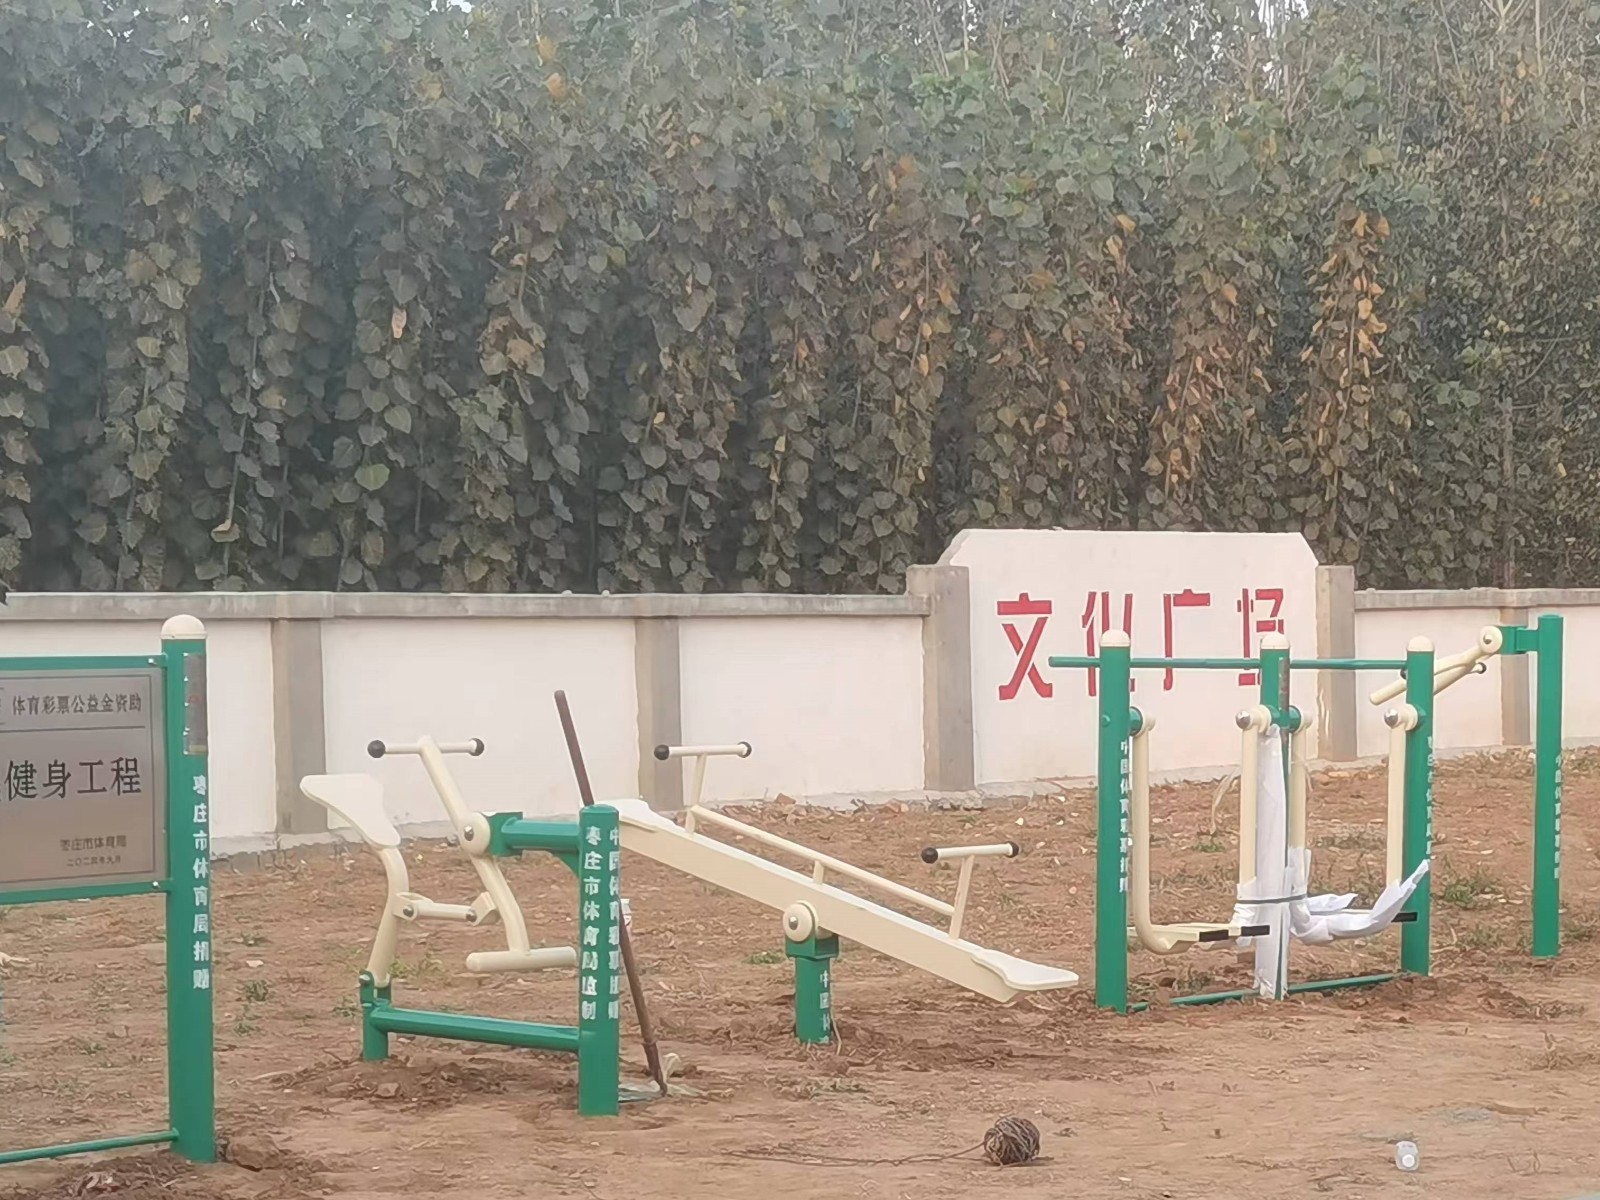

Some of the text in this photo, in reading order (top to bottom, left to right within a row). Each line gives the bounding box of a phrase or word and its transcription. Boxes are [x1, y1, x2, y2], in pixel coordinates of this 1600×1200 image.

[996, 588, 1284, 700] 文化广场
[12, 693, 142, 716] 体育彩票公益金资助
[4, 757, 142, 801] 健身工程
